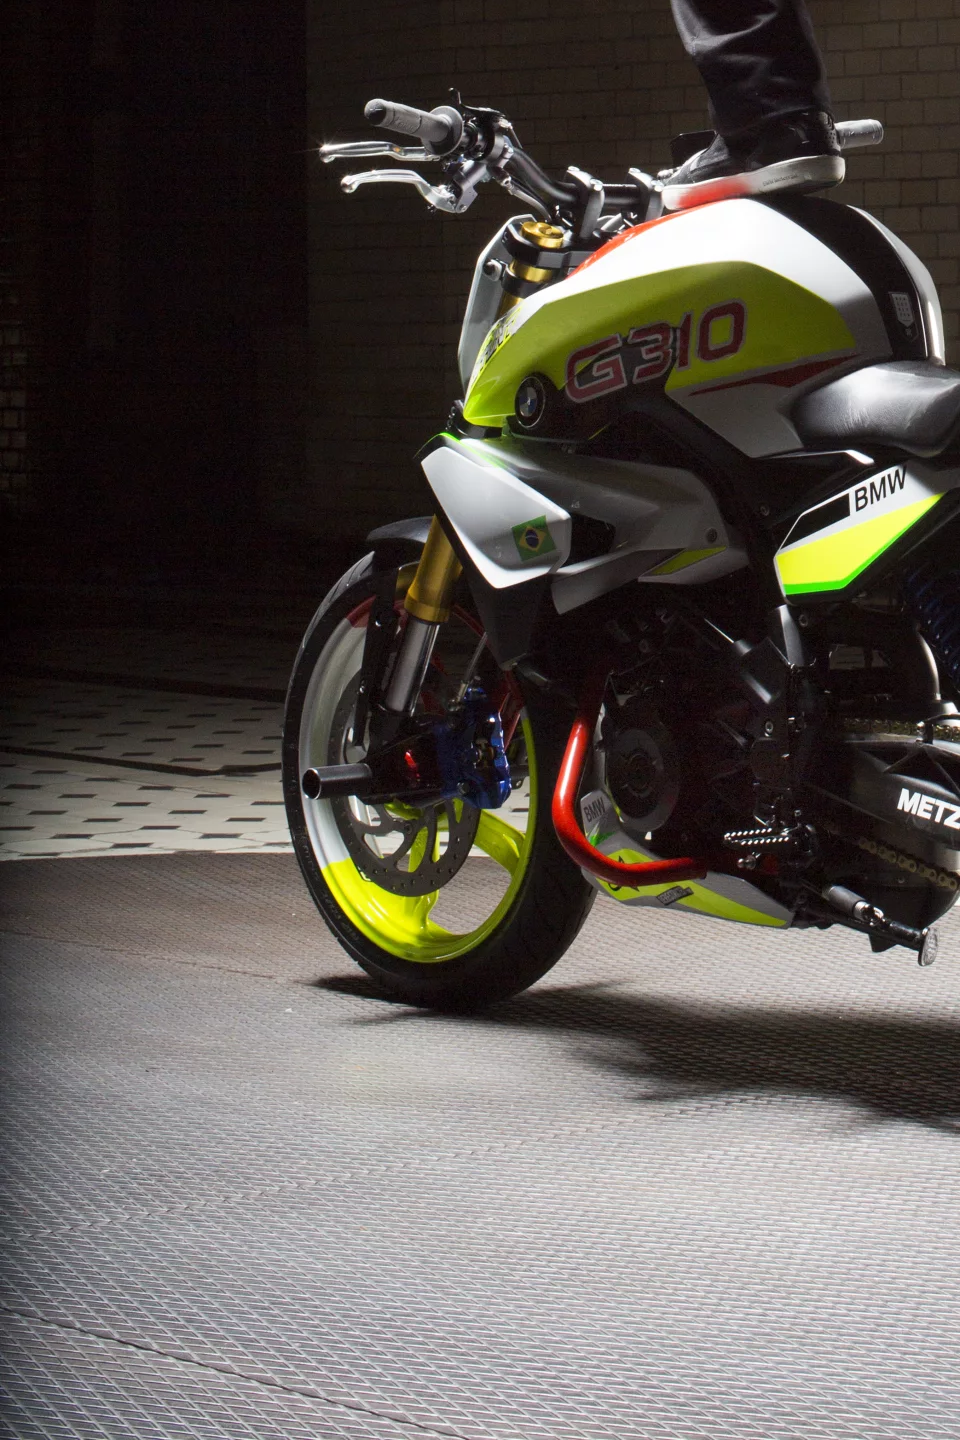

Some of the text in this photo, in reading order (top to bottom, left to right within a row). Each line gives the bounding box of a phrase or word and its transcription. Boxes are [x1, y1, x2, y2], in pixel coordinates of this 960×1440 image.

[565, 297, 748, 403] G310
[854, 464, 907, 512] BMW
[583, 797, 606, 823] BMW
